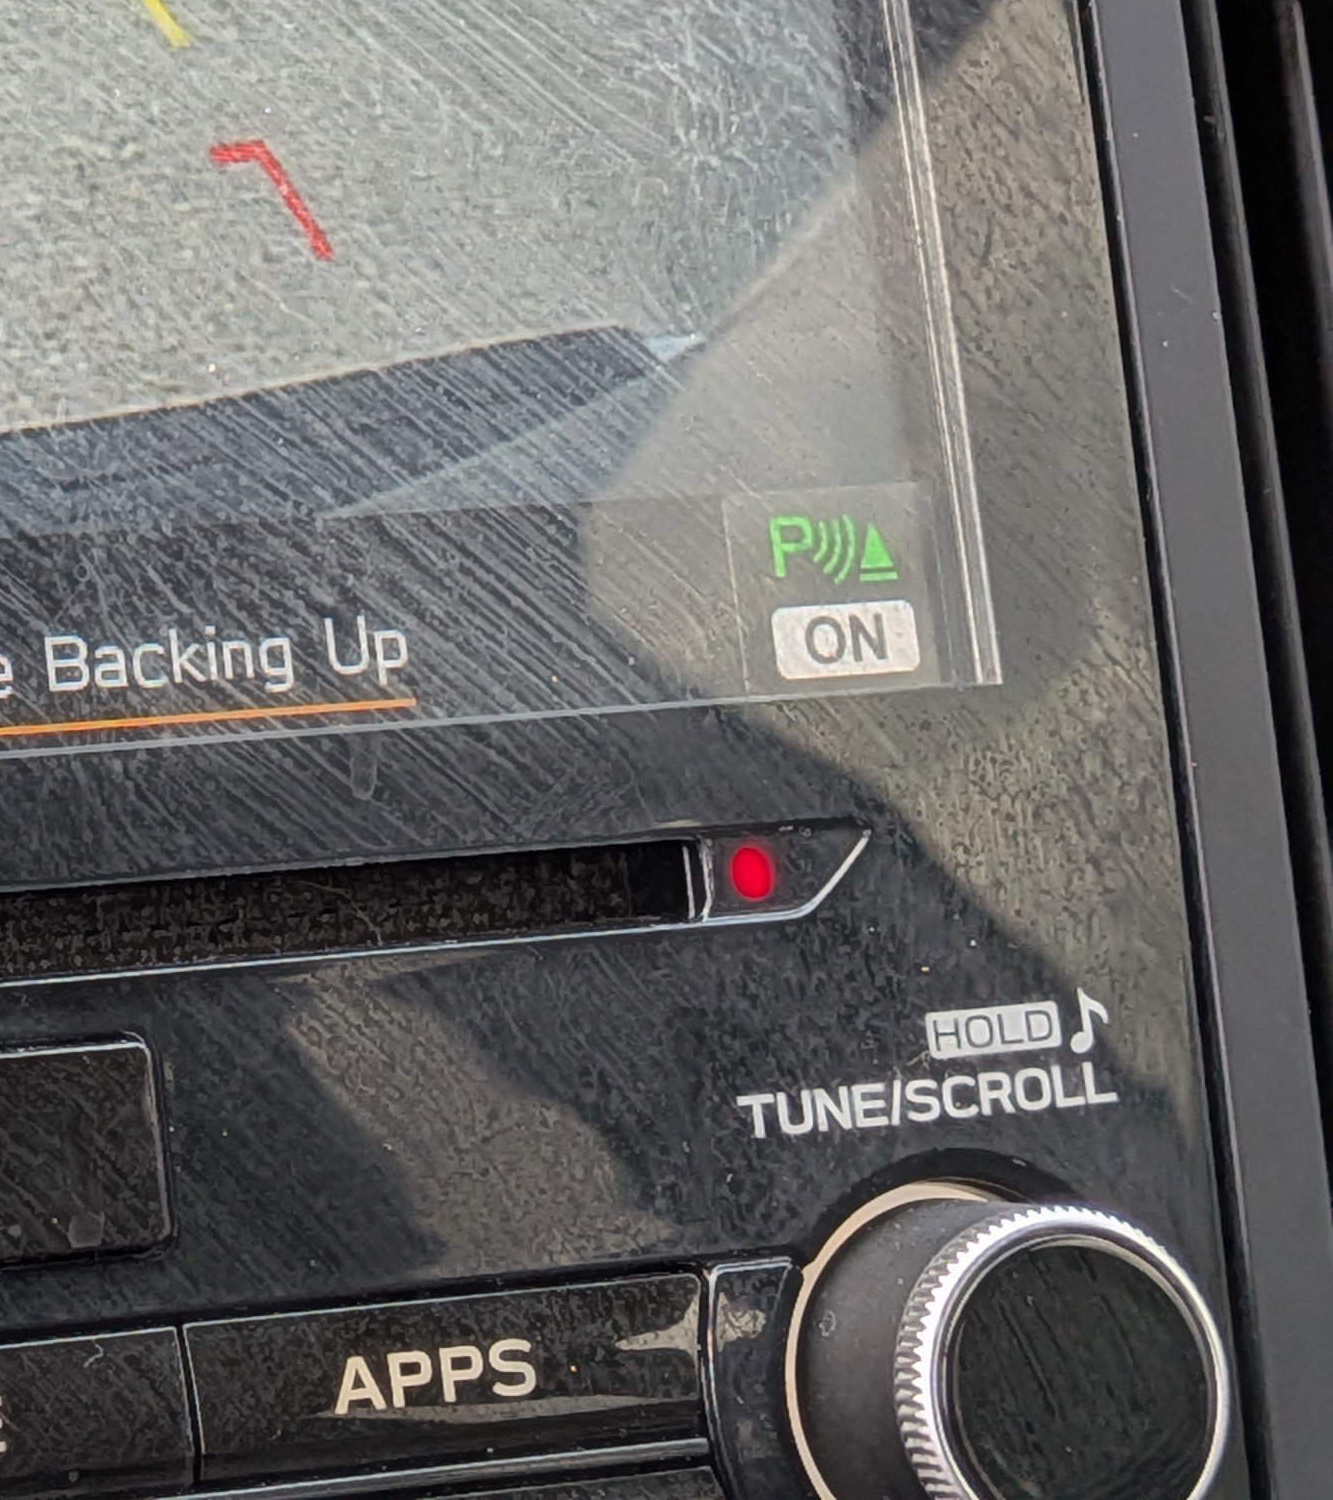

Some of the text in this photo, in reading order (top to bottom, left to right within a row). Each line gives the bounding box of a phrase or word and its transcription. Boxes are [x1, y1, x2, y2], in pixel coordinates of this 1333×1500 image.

[43, 625, 294, 693] Backing
[323, 615, 409, 686] Up
[804, 612, 889, 665] ON
[931, 1008, 1054, 1052] HOLD
[736, 1060, 1119, 1139] TUNE/SCROLL
[334, 1338, 537, 1415] APPS
